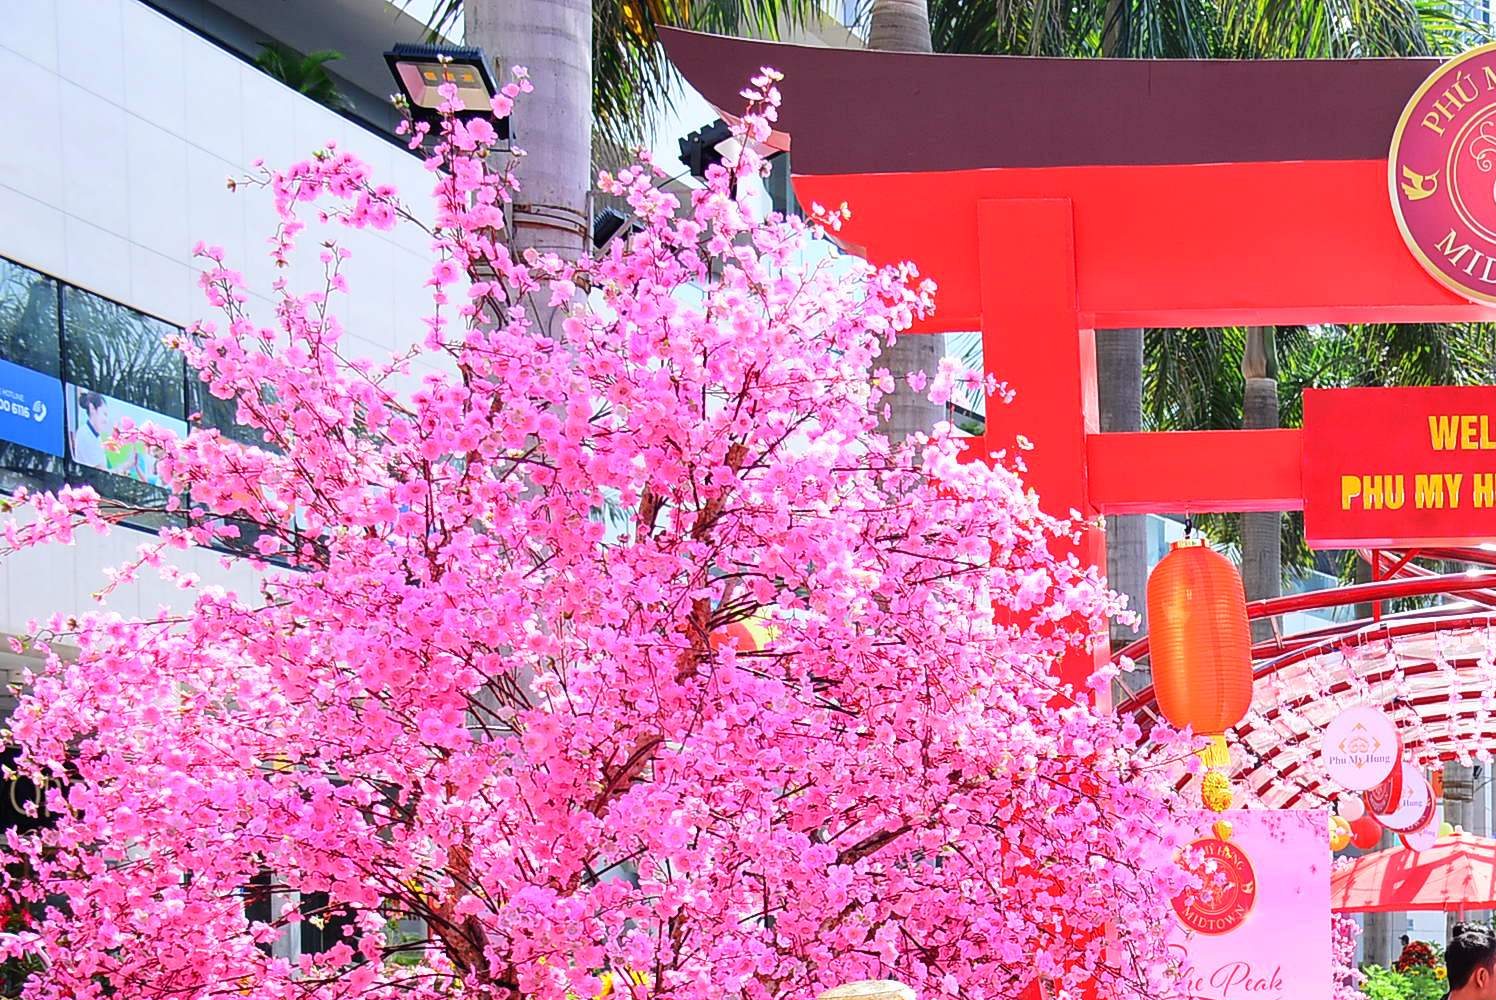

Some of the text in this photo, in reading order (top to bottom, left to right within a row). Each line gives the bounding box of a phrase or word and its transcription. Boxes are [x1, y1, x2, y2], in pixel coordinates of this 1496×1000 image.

[1420, 71, 1480, 137] PHÚ
[1341, 474, 1404, 510] PHU
[1414, 473, 1463, 509] MY
[1366, 754, 1391, 763] Hung
[1217, 846, 1244, 870] HNG
[1182, 904, 1245, 930] MIDTOWN
[1210, 961, 1283, 997] Peak
